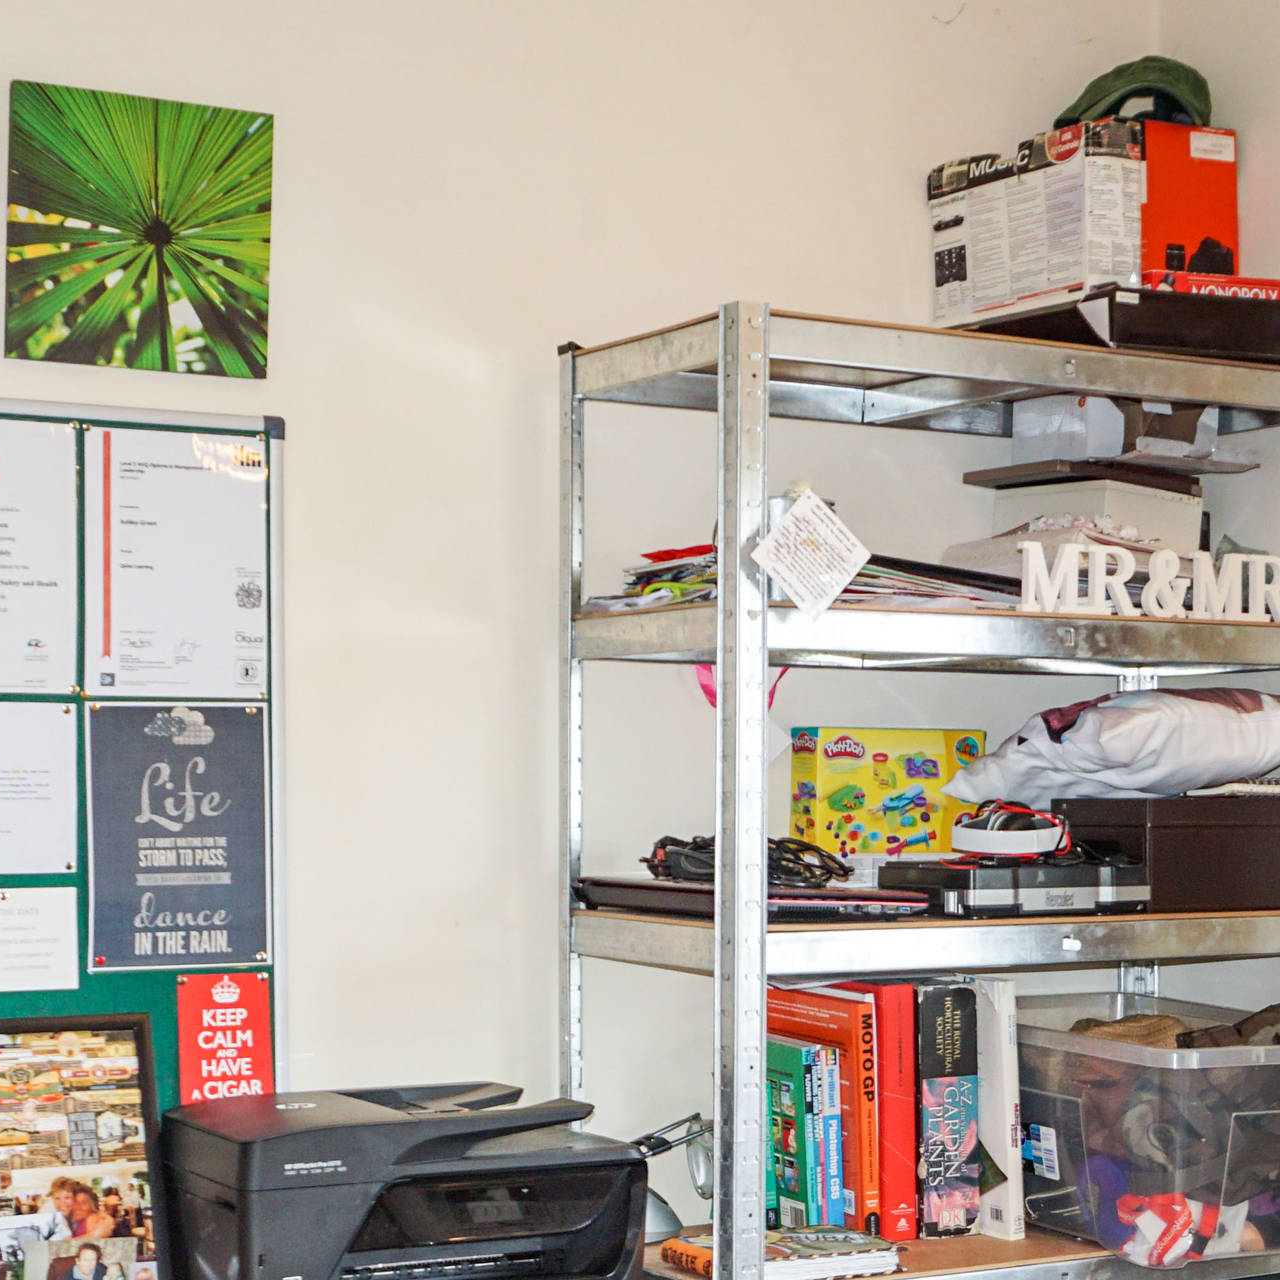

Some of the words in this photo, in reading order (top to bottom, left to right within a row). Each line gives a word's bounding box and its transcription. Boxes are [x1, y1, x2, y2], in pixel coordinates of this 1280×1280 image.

[824, 738, 865, 757] Play-Doh
[135, 756, 231, 832] Life
[138, 849, 177, 867] STORM
[179, 849, 194, 867] TO
[133, 891, 233, 928] dance
[134, 931, 153, 955] IN
[155, 930, 187, 955] THE
[189, 929, 233, 954] RAIN.
[201, 1007, 248, 1027] KEEP
[953, 1009, 961, 1029] THE
[197, 1029, 254, 1049] CALM
[861, 1013, 874, 1071] MOTO
[935, 1015, 944, 1056] SOCIETY
[216, 1048, 238, 1058] AND
[201, 1057, 253, 1078] HAVE
[190, 1088, 202, 1101] A
[202, 1079, 264, 1100] CIGAR
[862, 1074, 876, 1103] GP
[943, 1086, 961, 1178] GARDEN
[828, 1119, 839, 1176] Photoshop
[928, 1105, 945, 1187] PLANTS
[939, 1209, 962, 1228] DK
